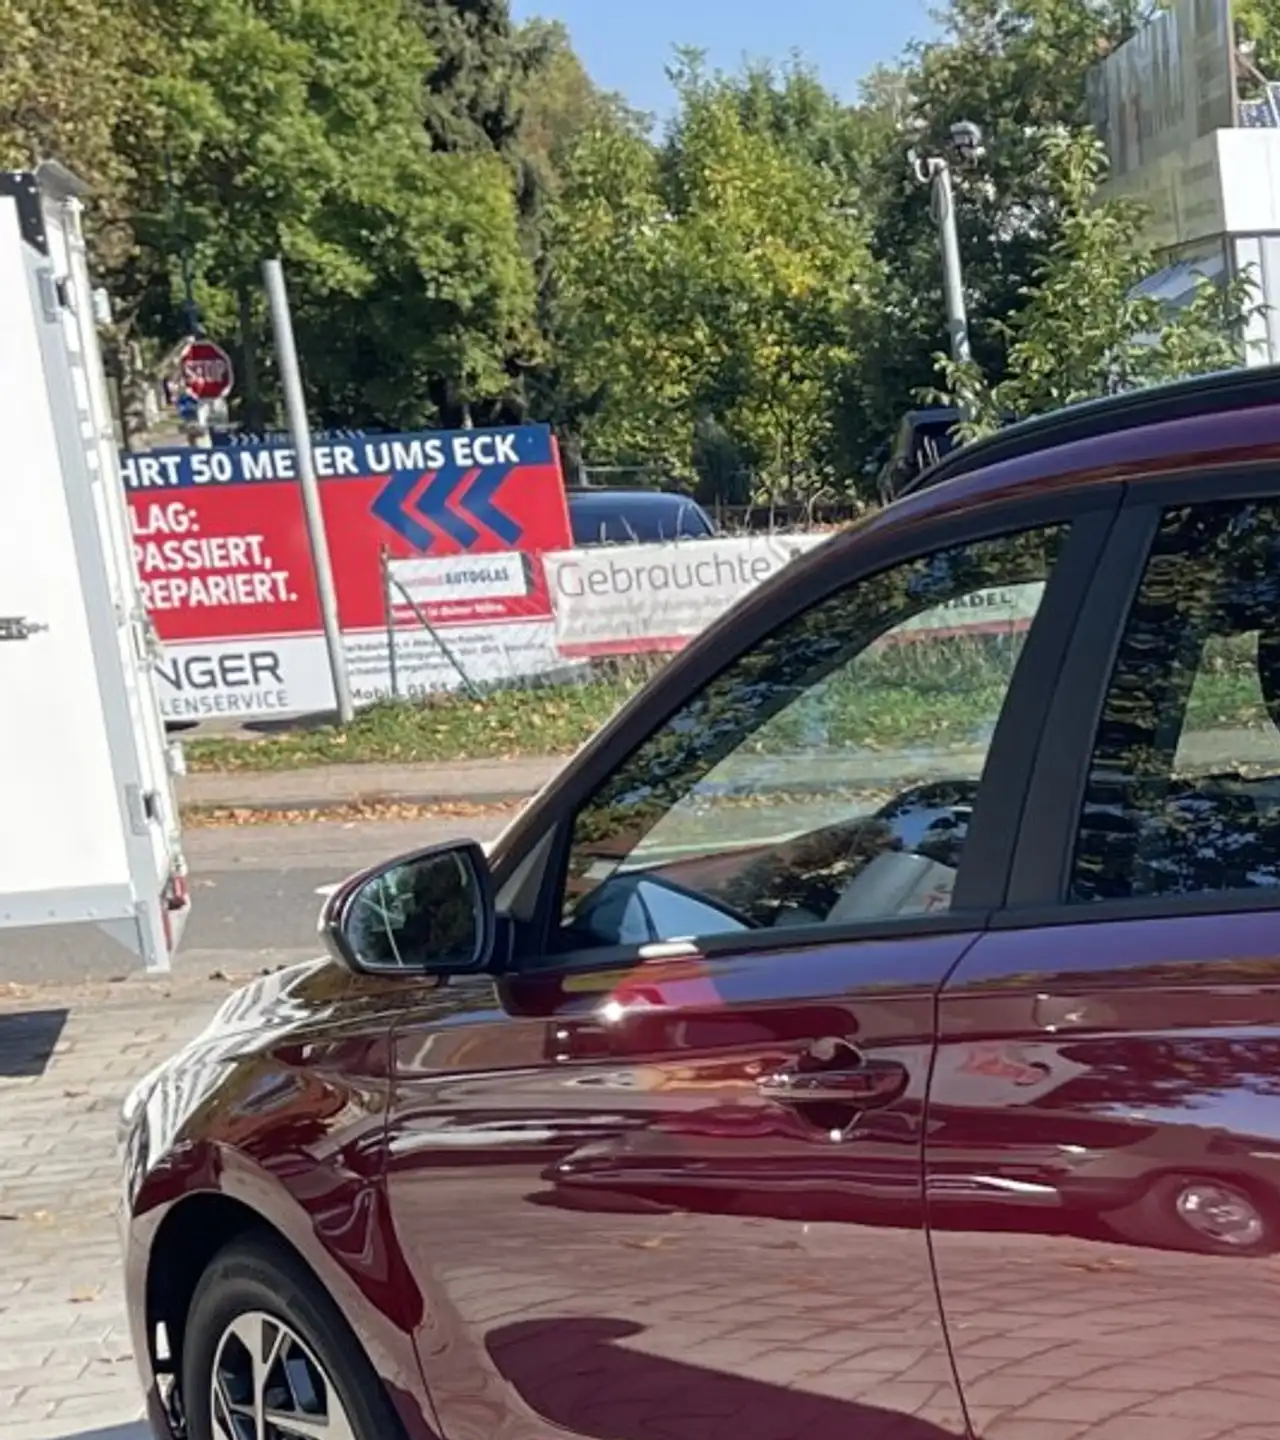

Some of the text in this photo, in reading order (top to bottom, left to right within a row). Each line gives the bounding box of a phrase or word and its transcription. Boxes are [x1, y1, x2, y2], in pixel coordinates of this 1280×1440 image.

[184, 359, 225, 383] STOP
[190, 451, 233, 484] 50
[240, 445, 359, 481] MEER
[364, 438, 445, 473] UMS
[451, 433, 519, 467] ECK
[556, 551, 772, 598] Gebrauchte
